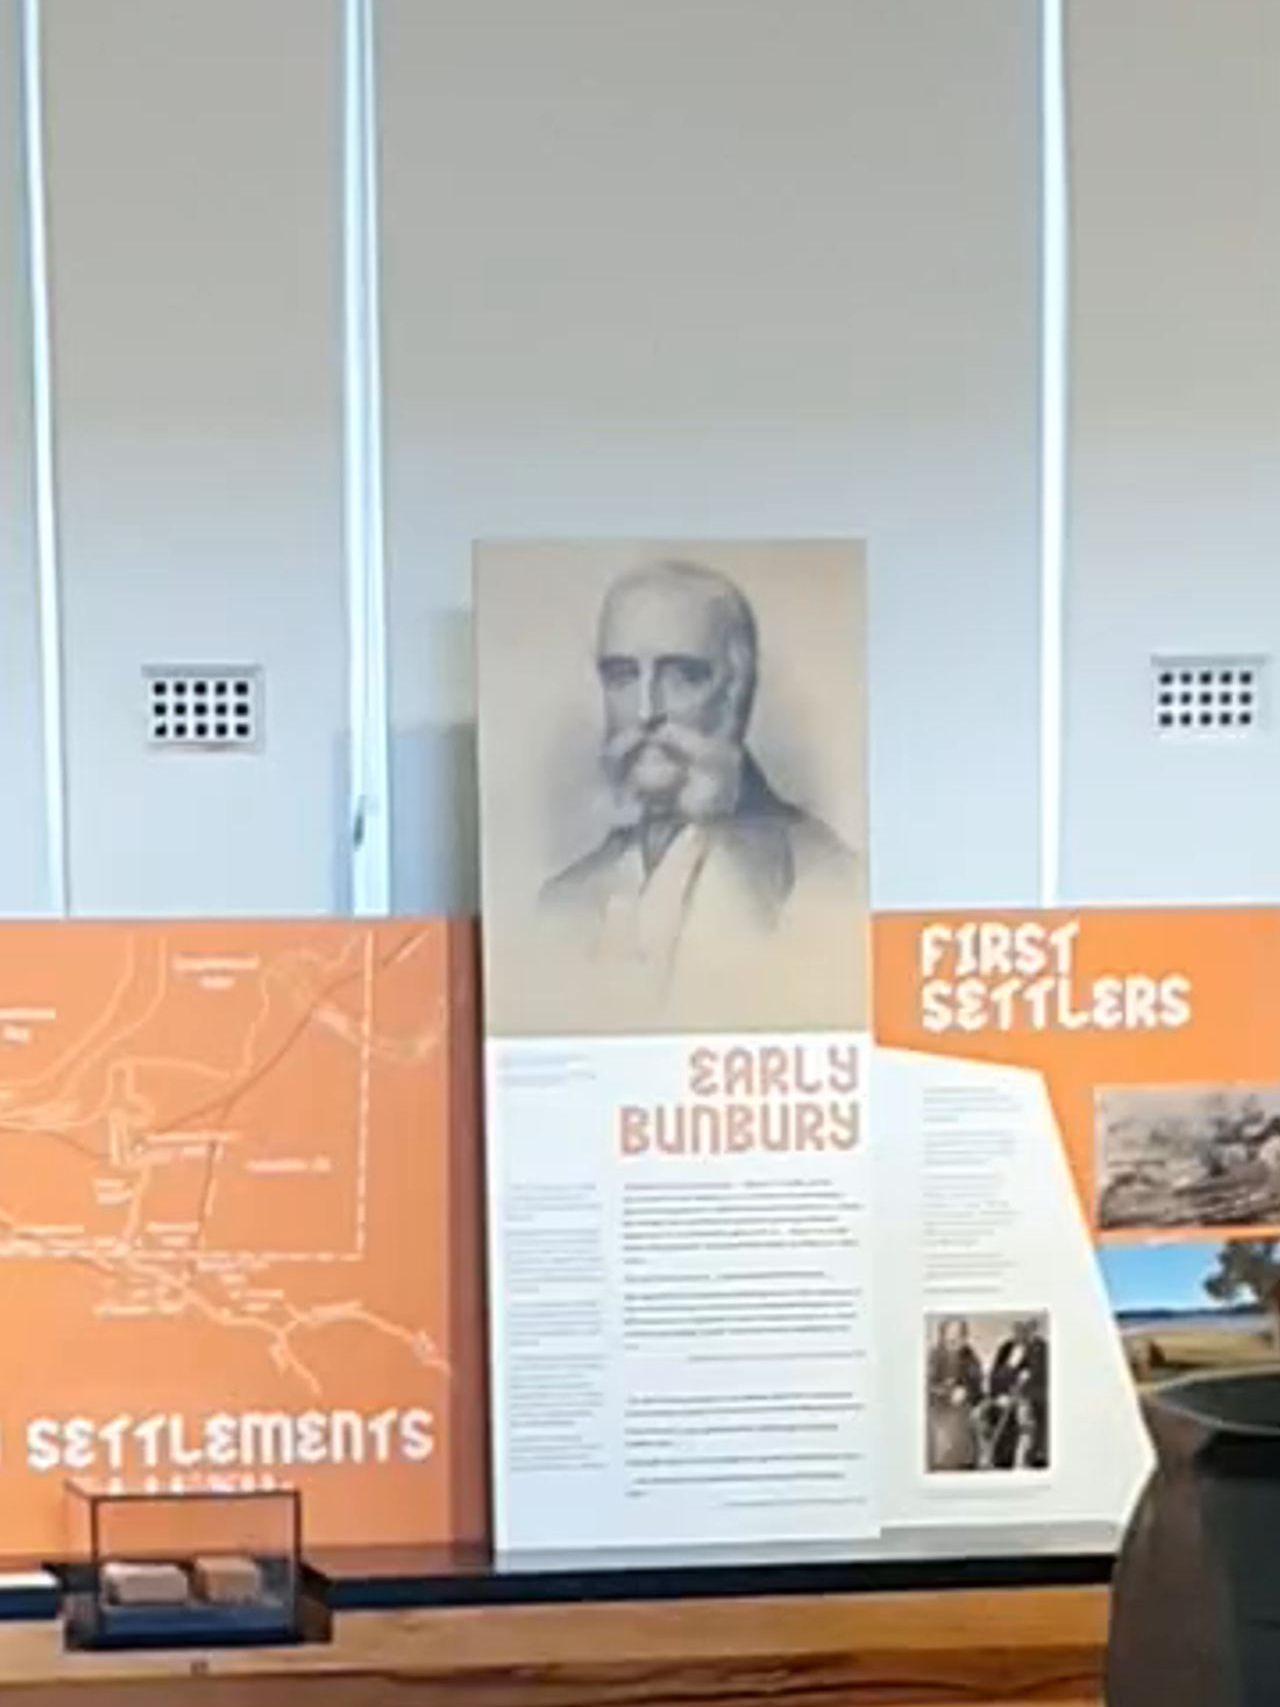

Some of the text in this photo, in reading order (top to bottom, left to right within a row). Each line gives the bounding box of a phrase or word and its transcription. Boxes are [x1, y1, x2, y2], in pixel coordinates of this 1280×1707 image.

[921, 921, 1080, 977] FIRST
[921, 974, 1192, 1031] SETTLERS
[688, 1043, 860, 1096] EARLY
[618, 1098, 861, 1156] BUNBURY
[25, 1408, 435, 1470] SETTLEMENTS
